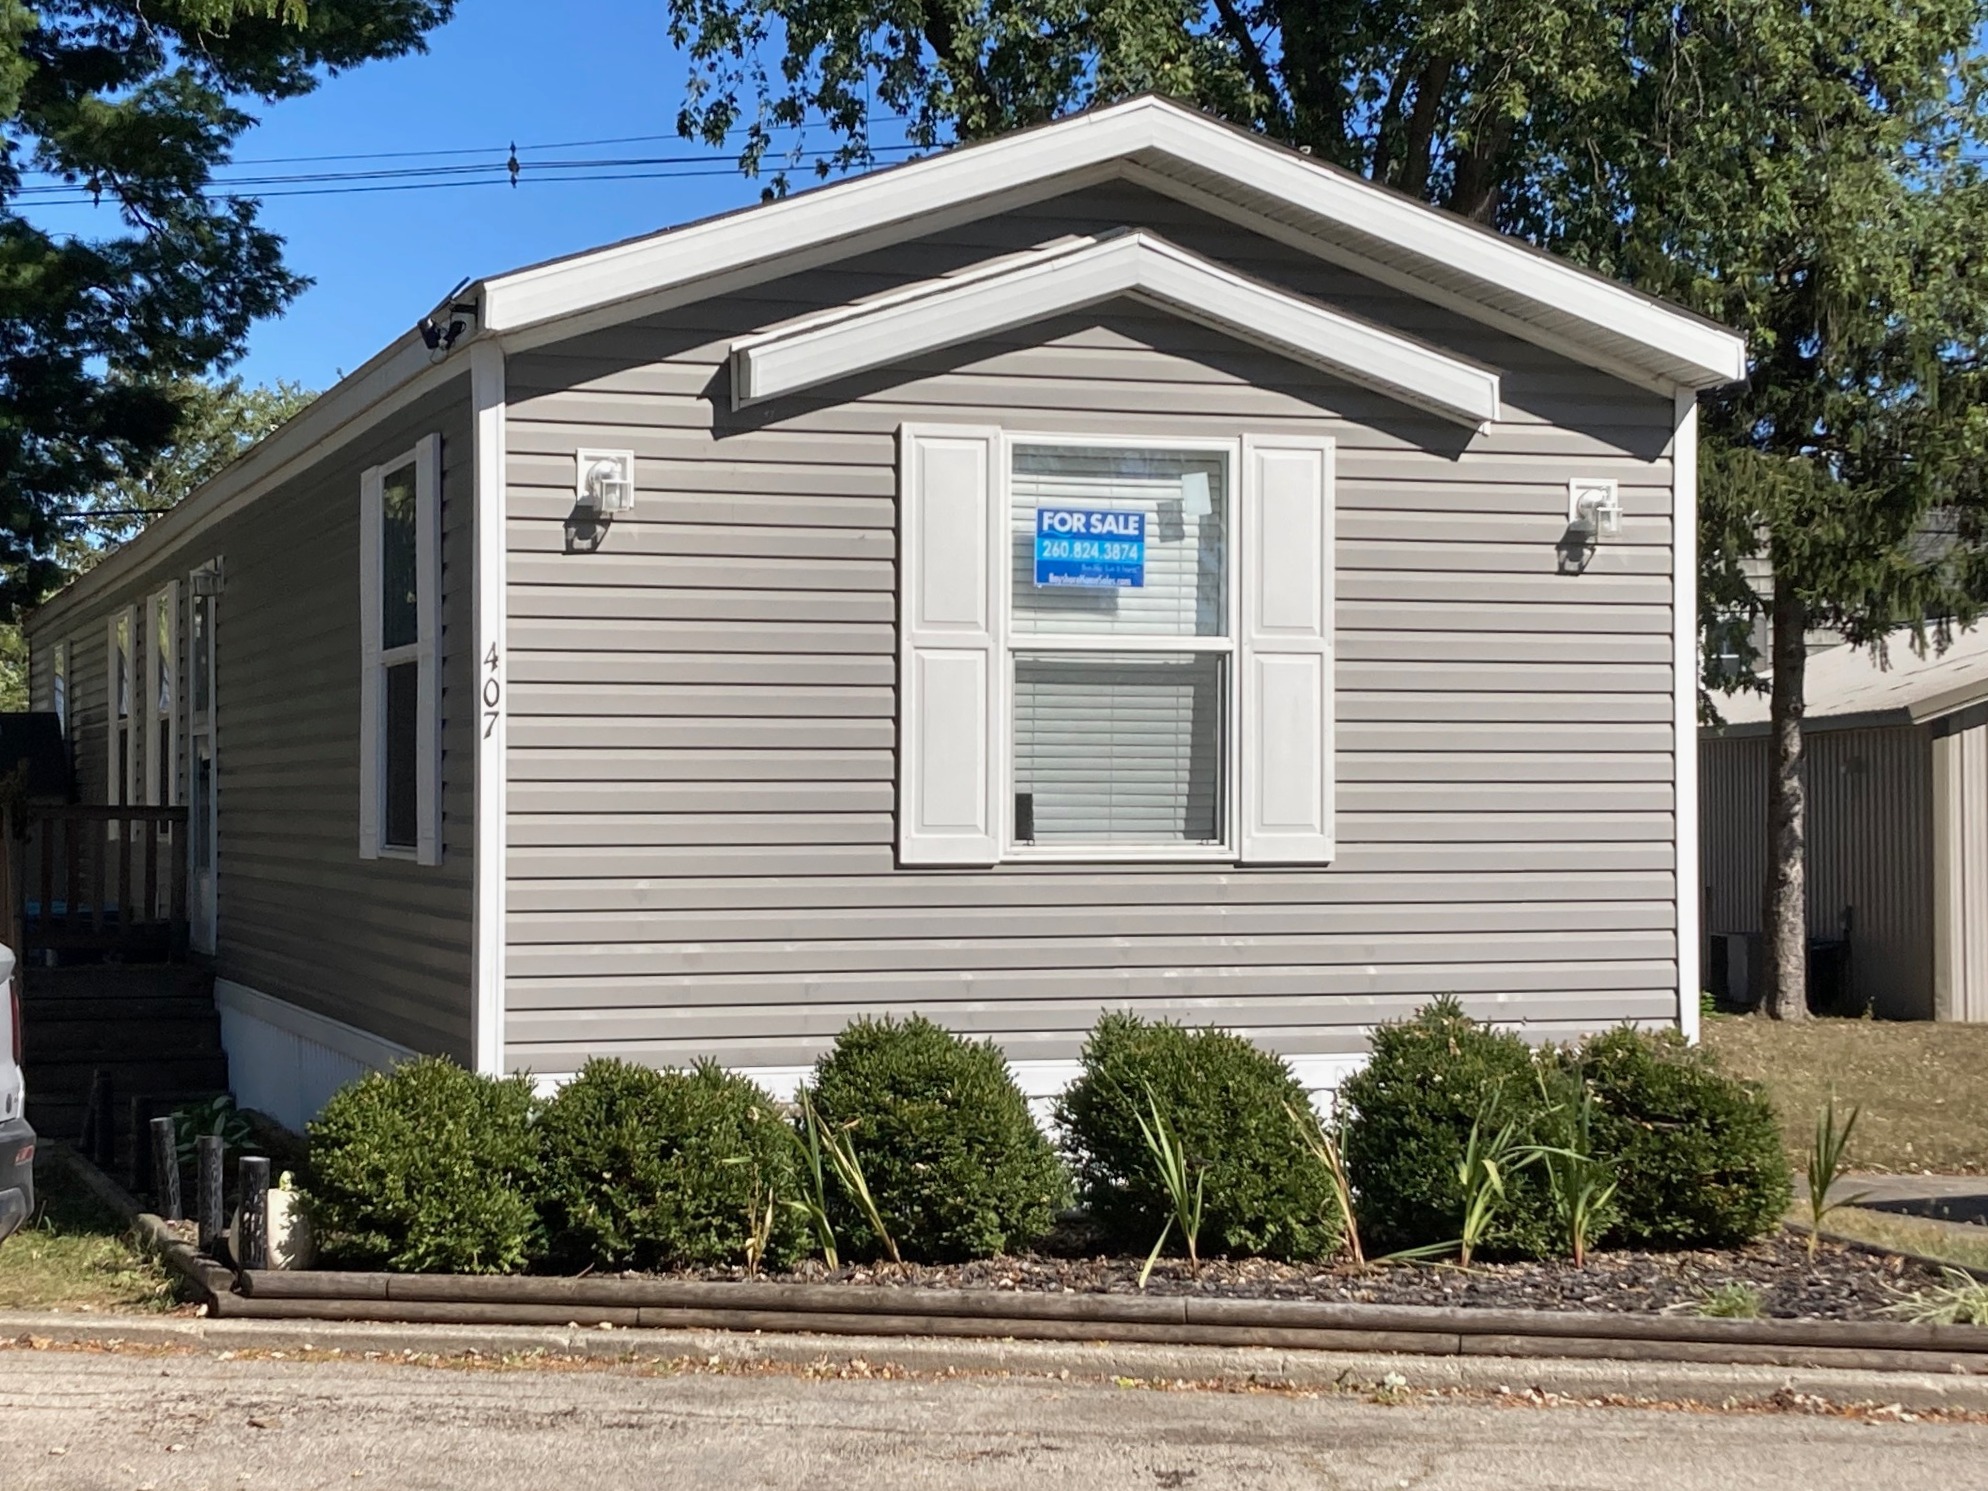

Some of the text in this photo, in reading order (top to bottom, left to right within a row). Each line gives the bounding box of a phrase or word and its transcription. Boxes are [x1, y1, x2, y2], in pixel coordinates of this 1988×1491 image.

[1043, 511, 1139, 535] FOR SALE
[1042, 540, 1138, 562] 260.824.3874
[483, 641, 500, 740] 407
